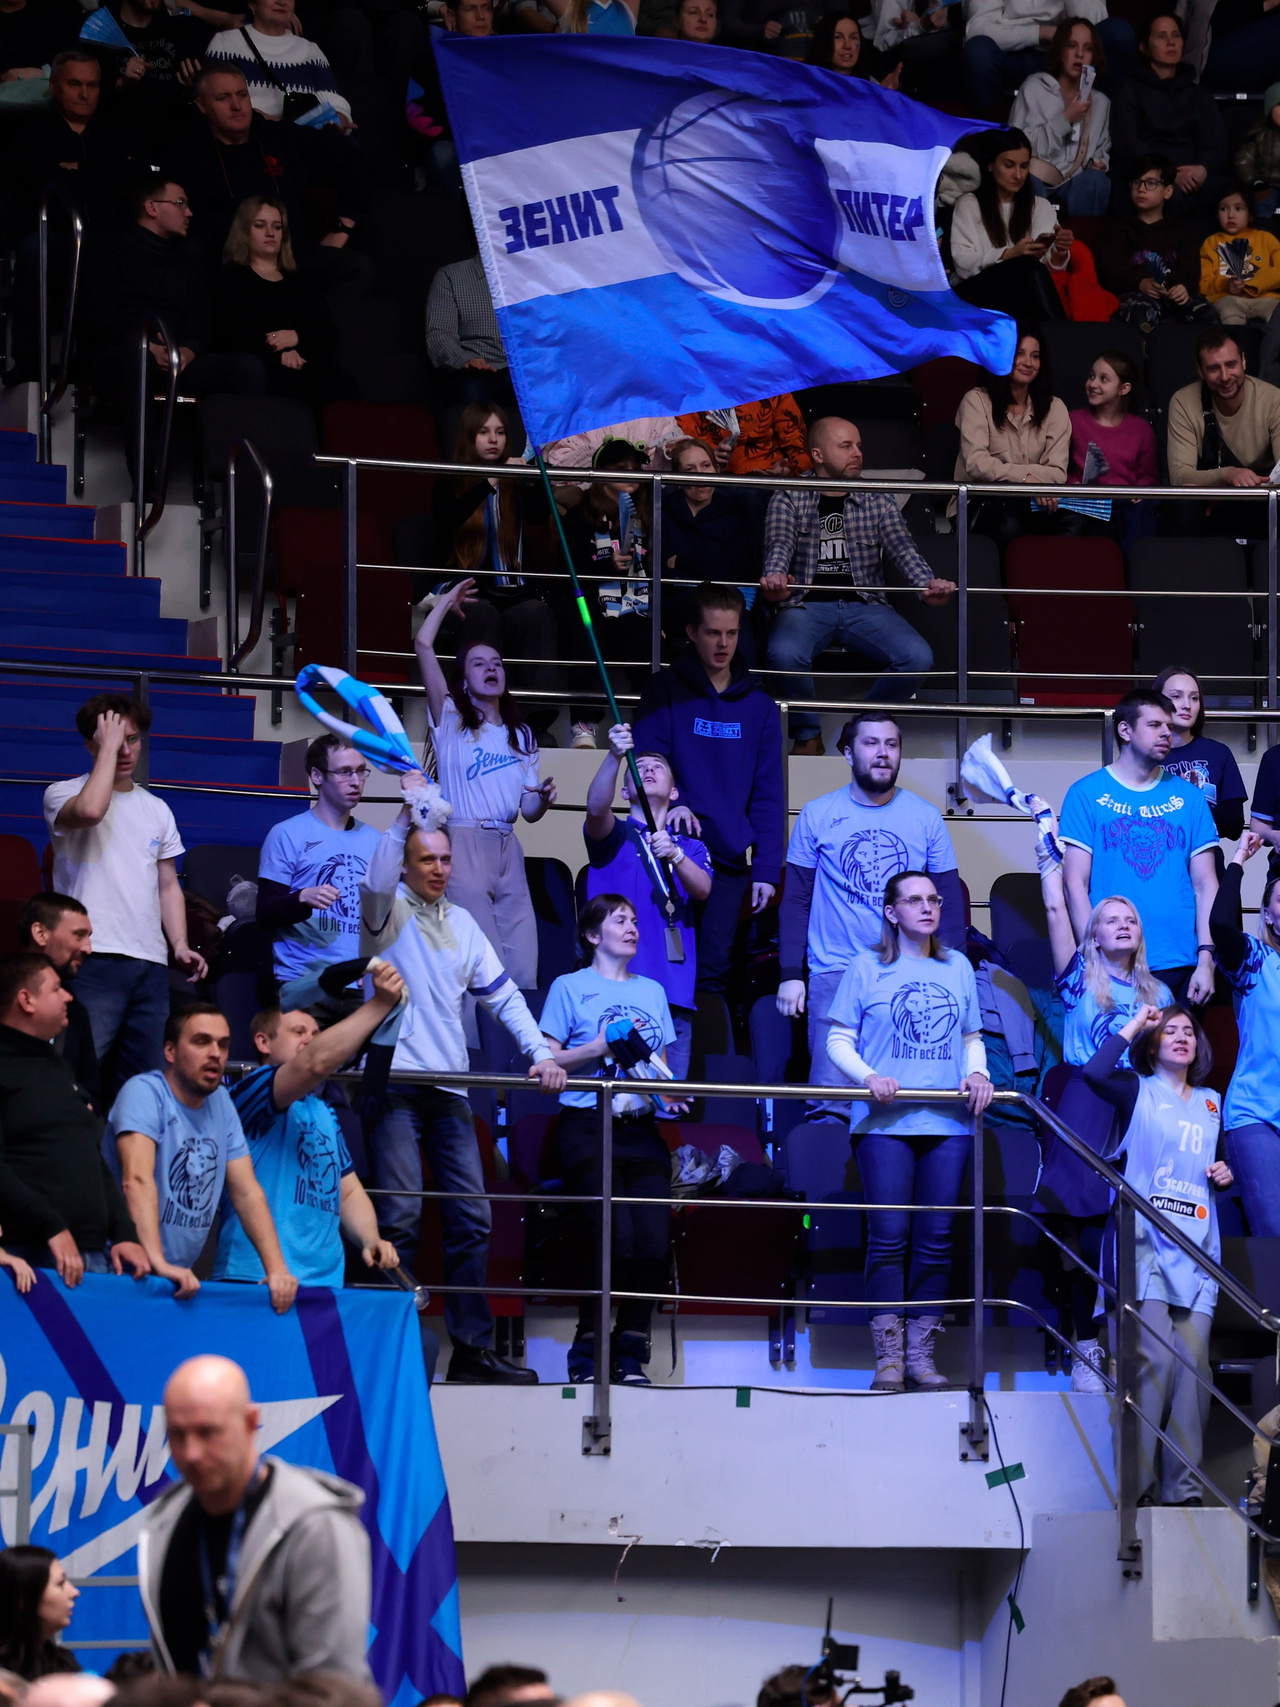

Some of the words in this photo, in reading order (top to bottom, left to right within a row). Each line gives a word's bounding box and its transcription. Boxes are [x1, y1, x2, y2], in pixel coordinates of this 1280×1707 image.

[498, 185, 623, 254] ЗЕНИТ
[835, 188, 925, 241] ПИТЕР
[330, 916, 346, 934] ЛЕТ
[891, 1033, 900, 1059] 10
[901, 1042, 918, 1060] ЛЕТ
[1178, 1119, 1203, 1155] 78
[1153, 1197, 1194, 1215] Winline
